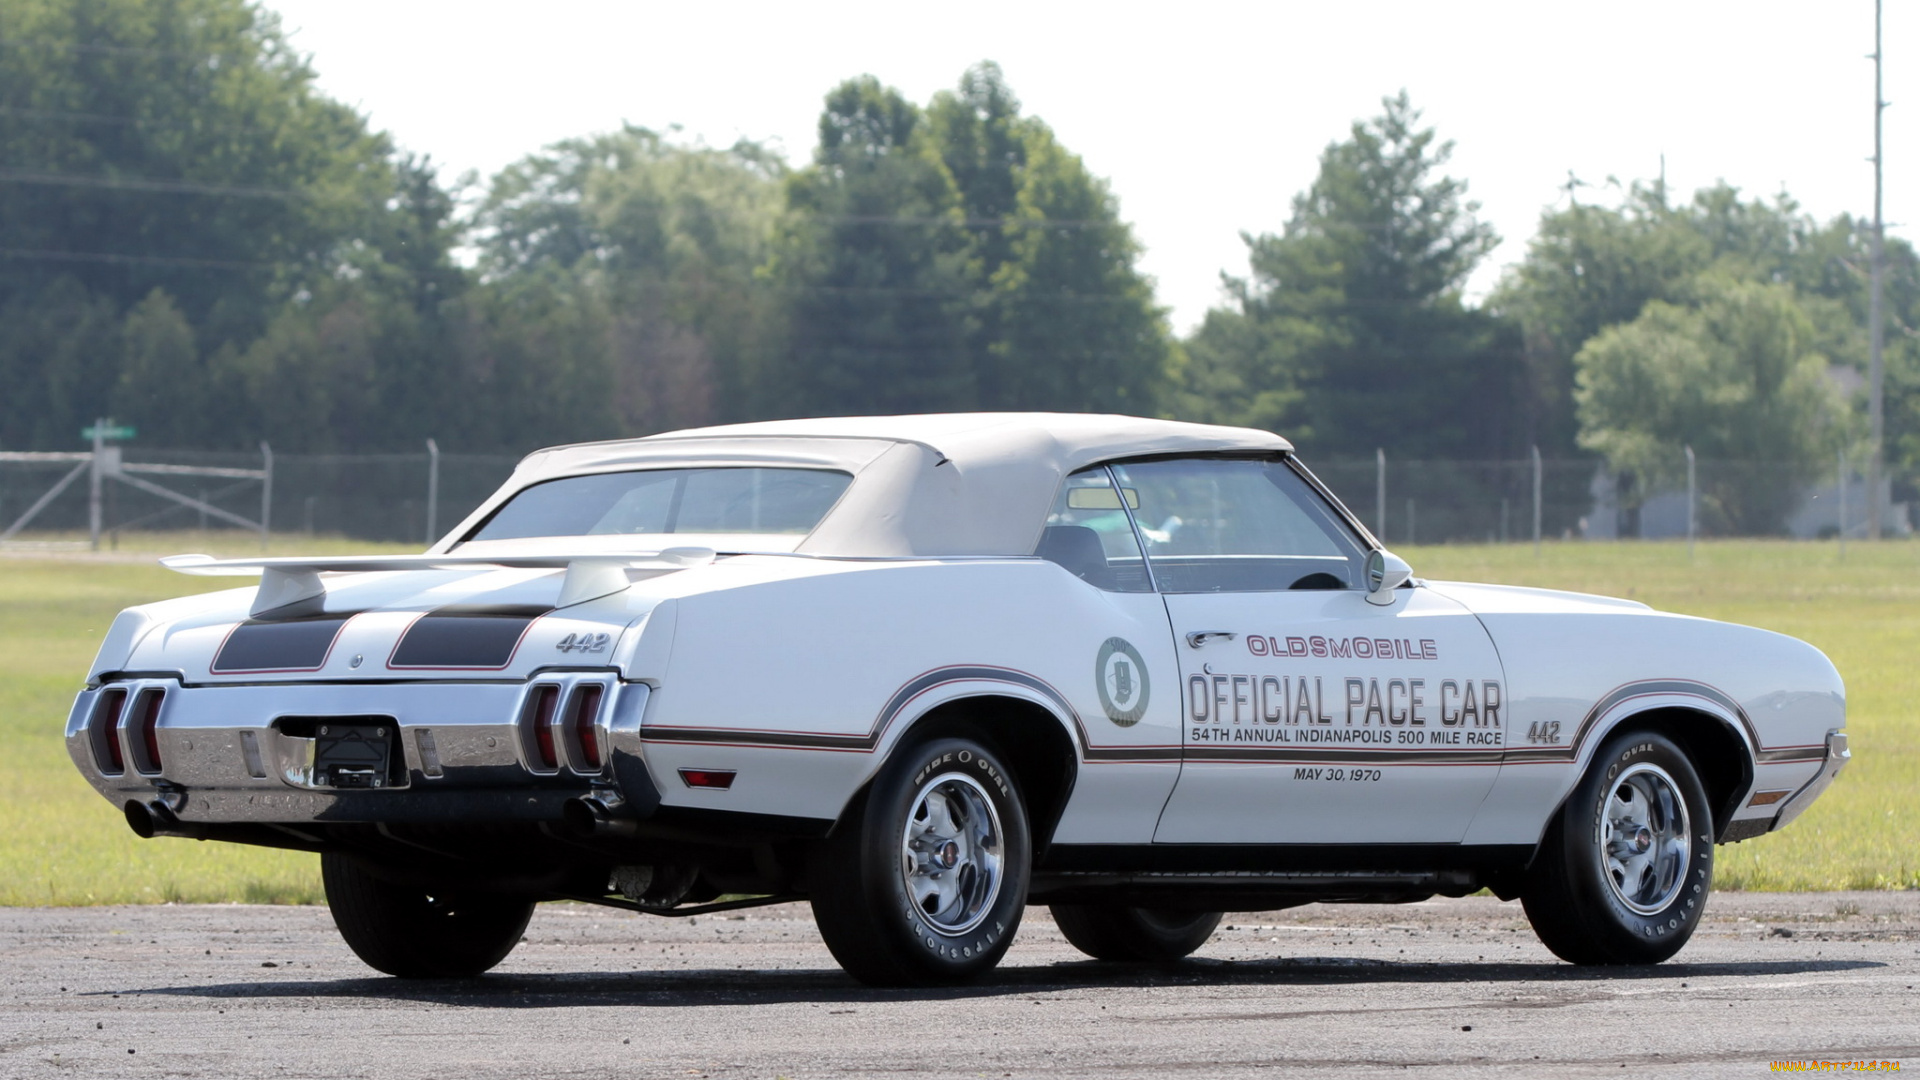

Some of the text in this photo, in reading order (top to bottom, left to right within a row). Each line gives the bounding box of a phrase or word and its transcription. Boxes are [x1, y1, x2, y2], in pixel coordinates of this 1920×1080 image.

[556, 632, 611, 653] 442
[1246, 634, 1438, 660] OLDSMOBILE
[1187, 672, 1333, 726] OFFICIAL
[1344, 676, 1426, 728] PACE
[1439, 678, 1502, 729] CAR
[1191, 728, 1503, 745] 54TH ANNUAL INDIANAPOLIS 500 MILE RACE
[1526, 721, 1561, 744] 442
[1622, 744, 1654, 761] OVAL
[915, 753, 1008, 797] WIDE OVAL
[1293, 768, 1382, 782] MAY 30, 1970
